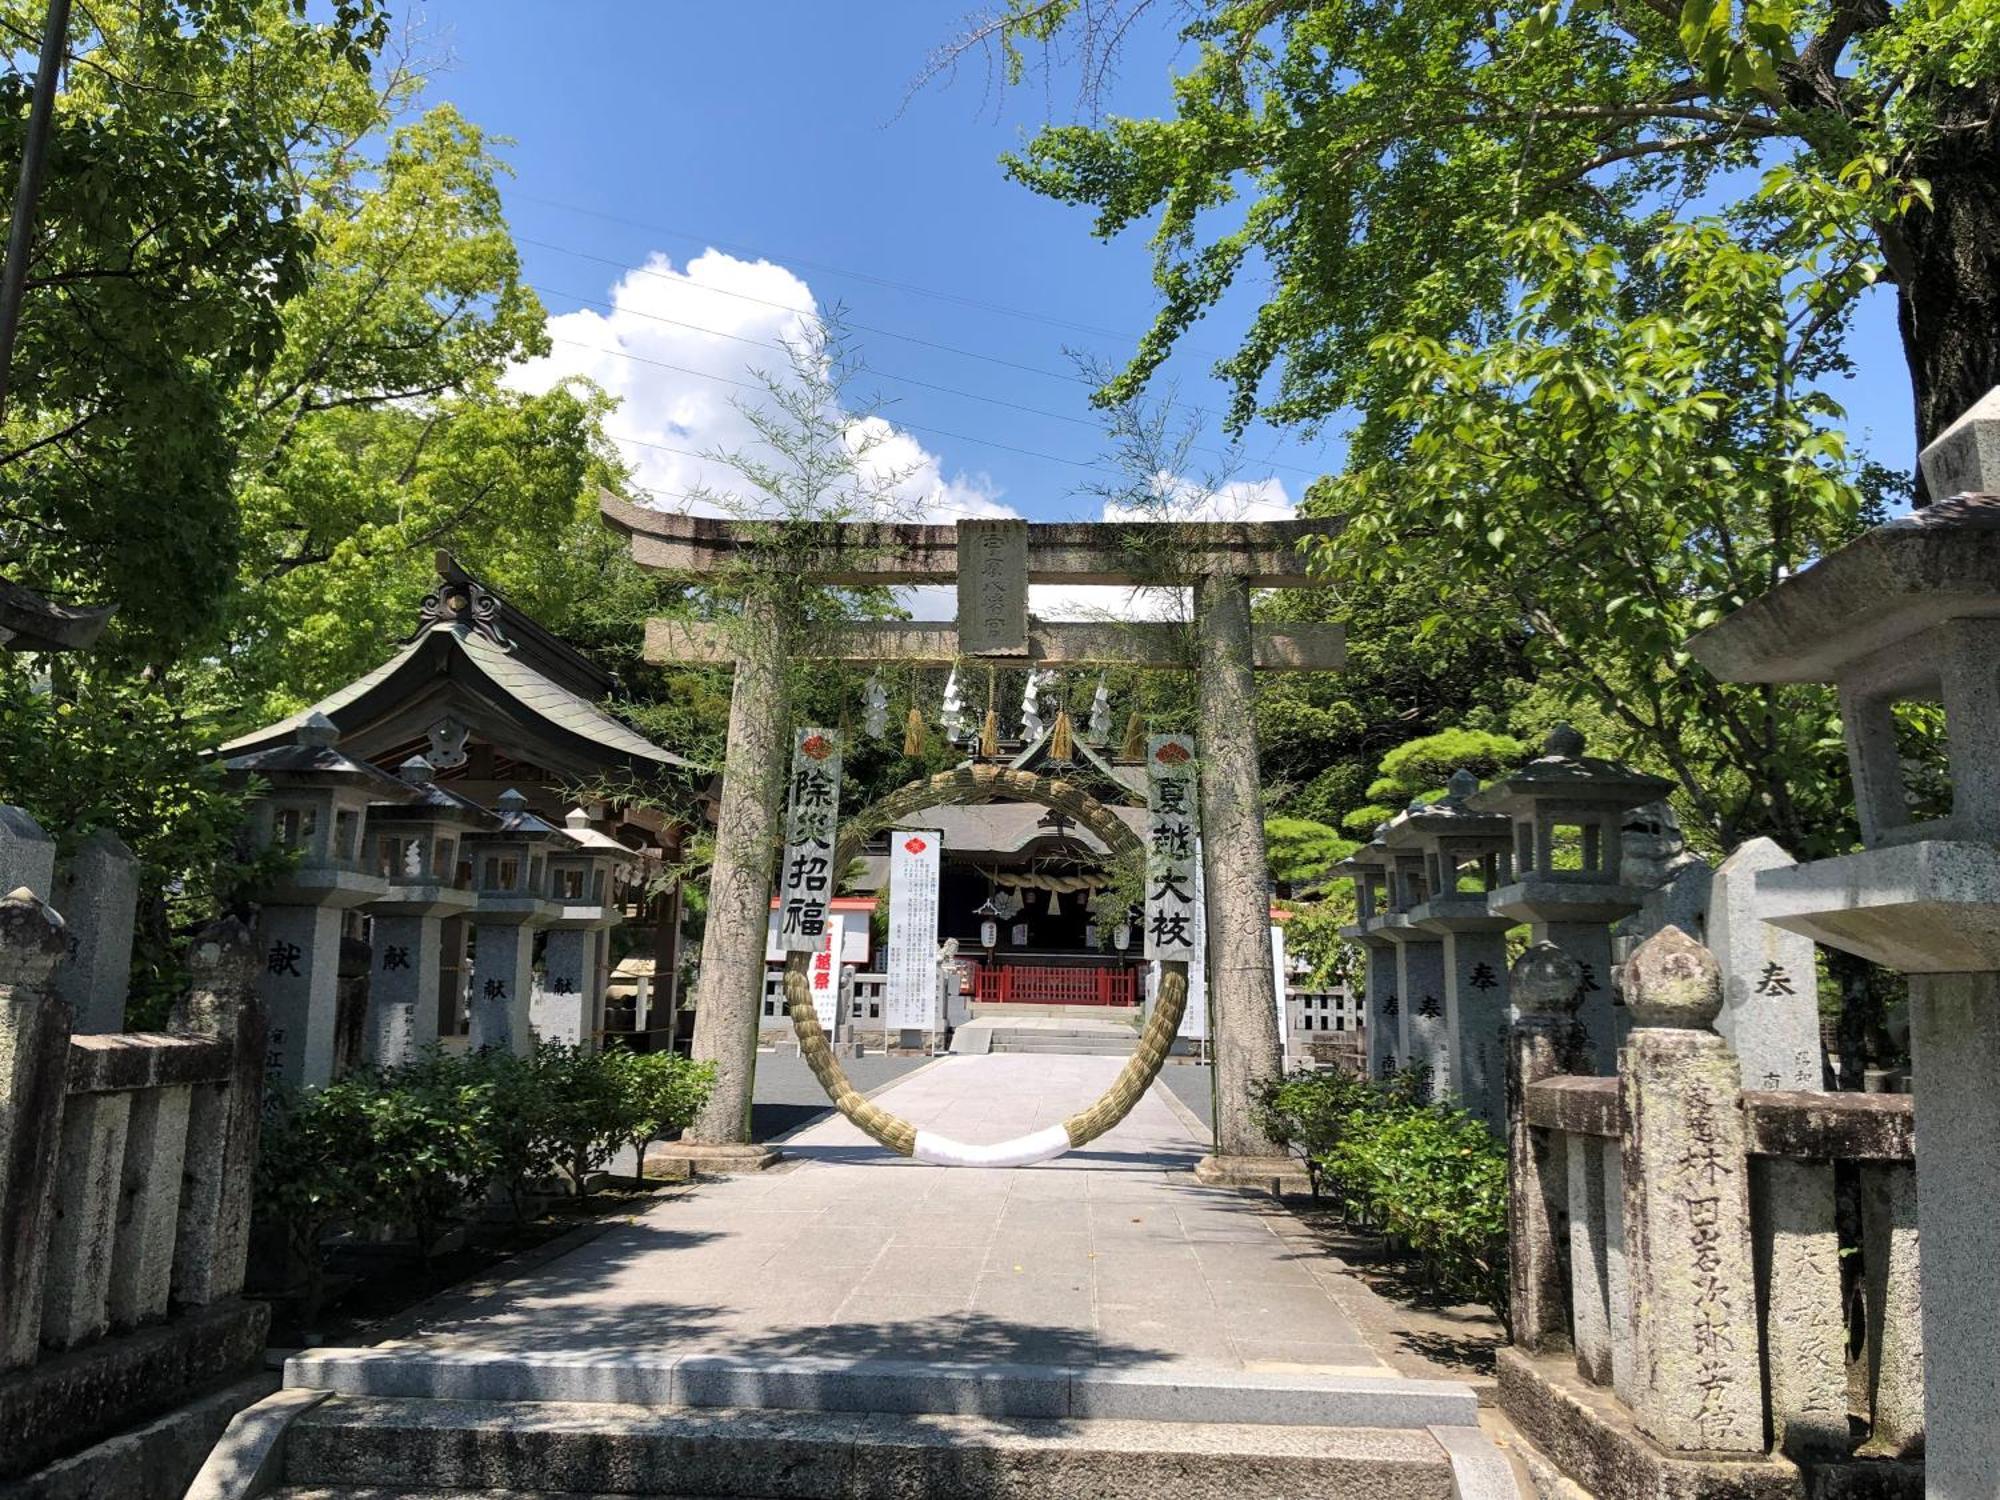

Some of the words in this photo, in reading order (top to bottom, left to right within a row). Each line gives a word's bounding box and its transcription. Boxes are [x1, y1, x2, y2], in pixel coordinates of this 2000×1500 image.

[783, 768, 834, 937] 除災招福
[267, 940, 302, 978] 献
[383, 945, 410, 971] 献
[484, 978, 506, 1000] 献
[1469, 961, 1498, 991] 奉
[1755, 960, 1797, 997] 奉
[1419, 995, 1442, 1018] 奉
